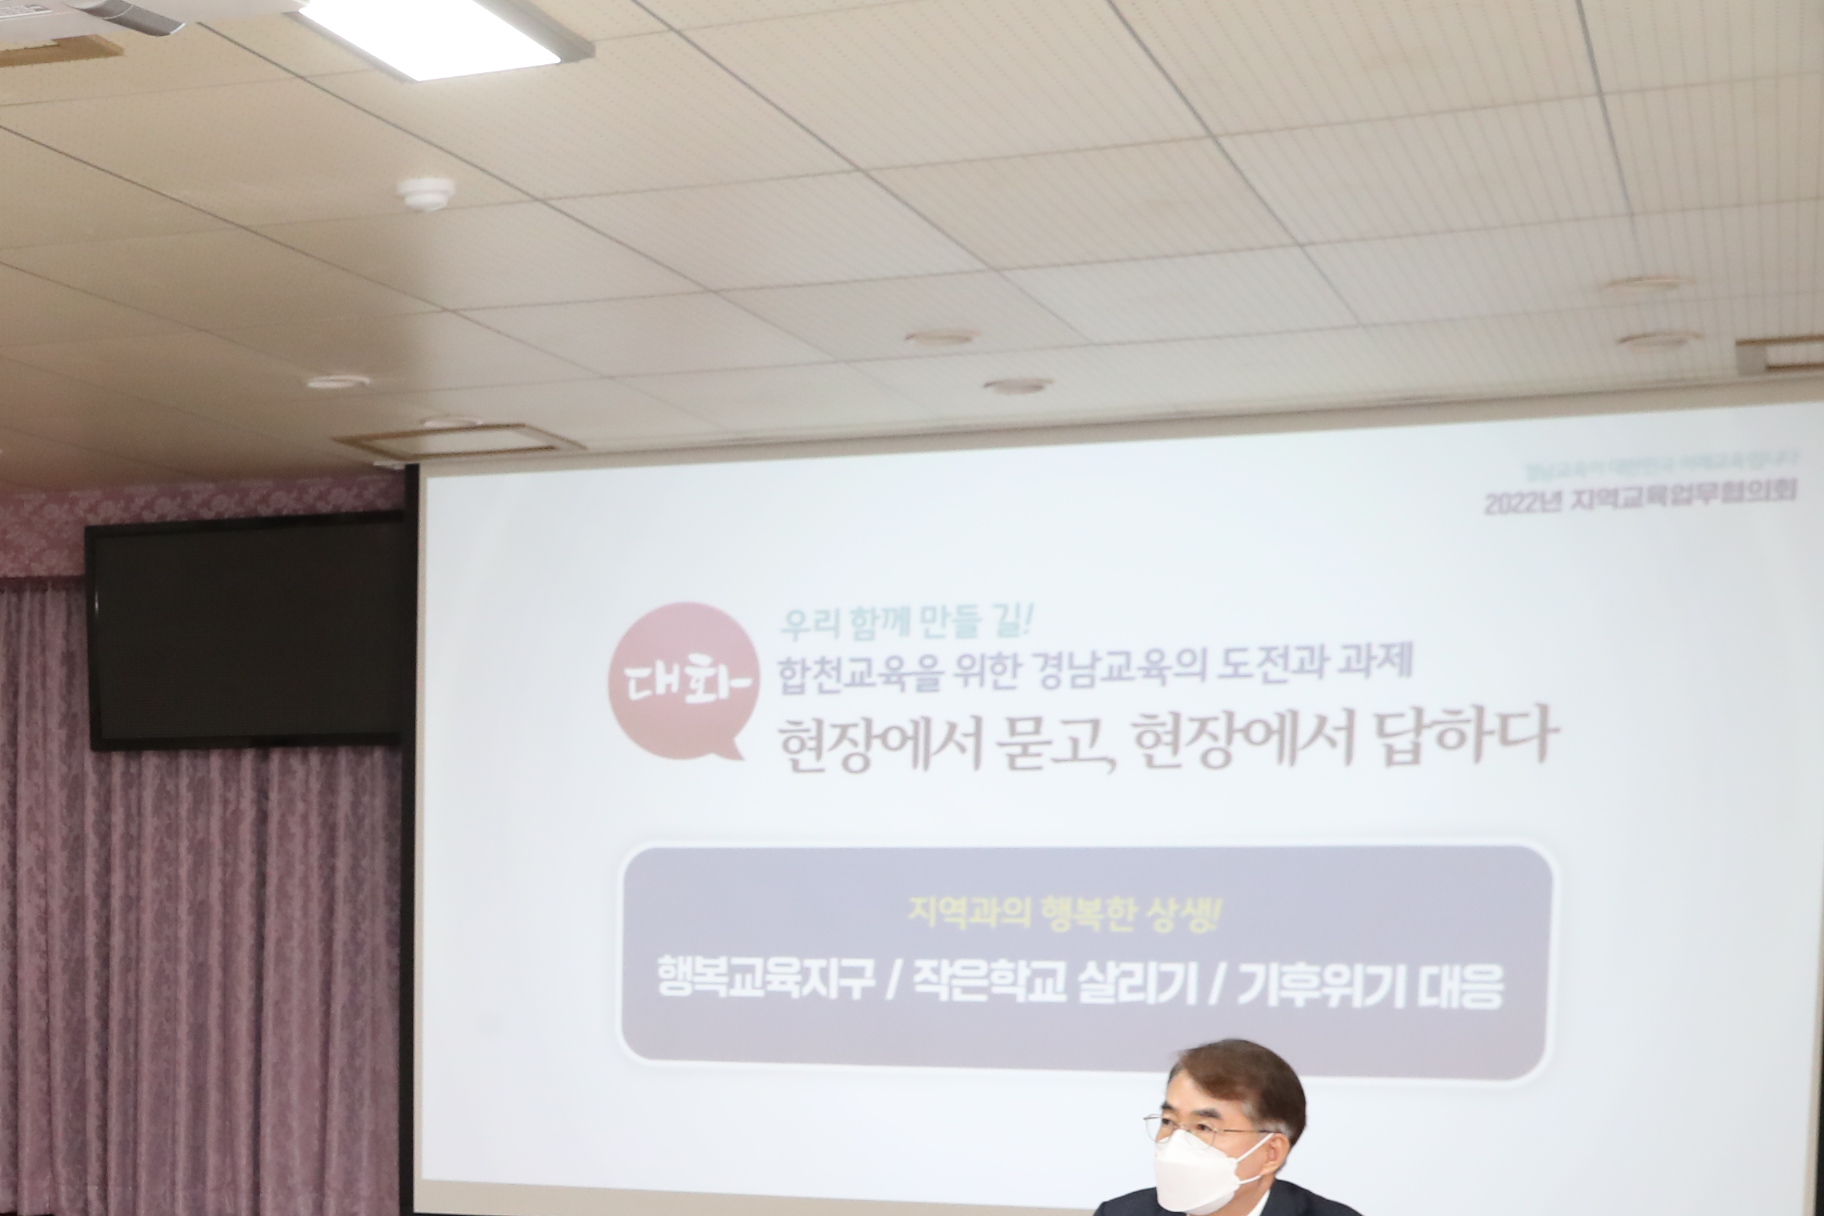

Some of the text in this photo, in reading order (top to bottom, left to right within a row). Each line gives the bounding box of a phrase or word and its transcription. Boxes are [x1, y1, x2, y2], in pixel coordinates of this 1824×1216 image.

[1483, 490, 1562, 516] 2022년
[779, 602, 1035, 641] 우리 함께 만들 길!
[622, 655, 752, 707] 대화
[778, 640, 1415, 696] 합천교육을 위한 경남교육의 도전과 과제
[778, 701, 1561, 776] 현장에서 묻고, 현장에서 답하다
[908, 894, 1223, 934] 지역과의 행복한 상생!
[656, 953, 877, 1002] 행복교육지구
[912, 957, 1069, 1004] 작은학교
[1077, 958, 1201, 1008] 살리기
[1237, 960, 1408, 1011] 기후위기
[1417, 962, 1505, 1012] 대응
